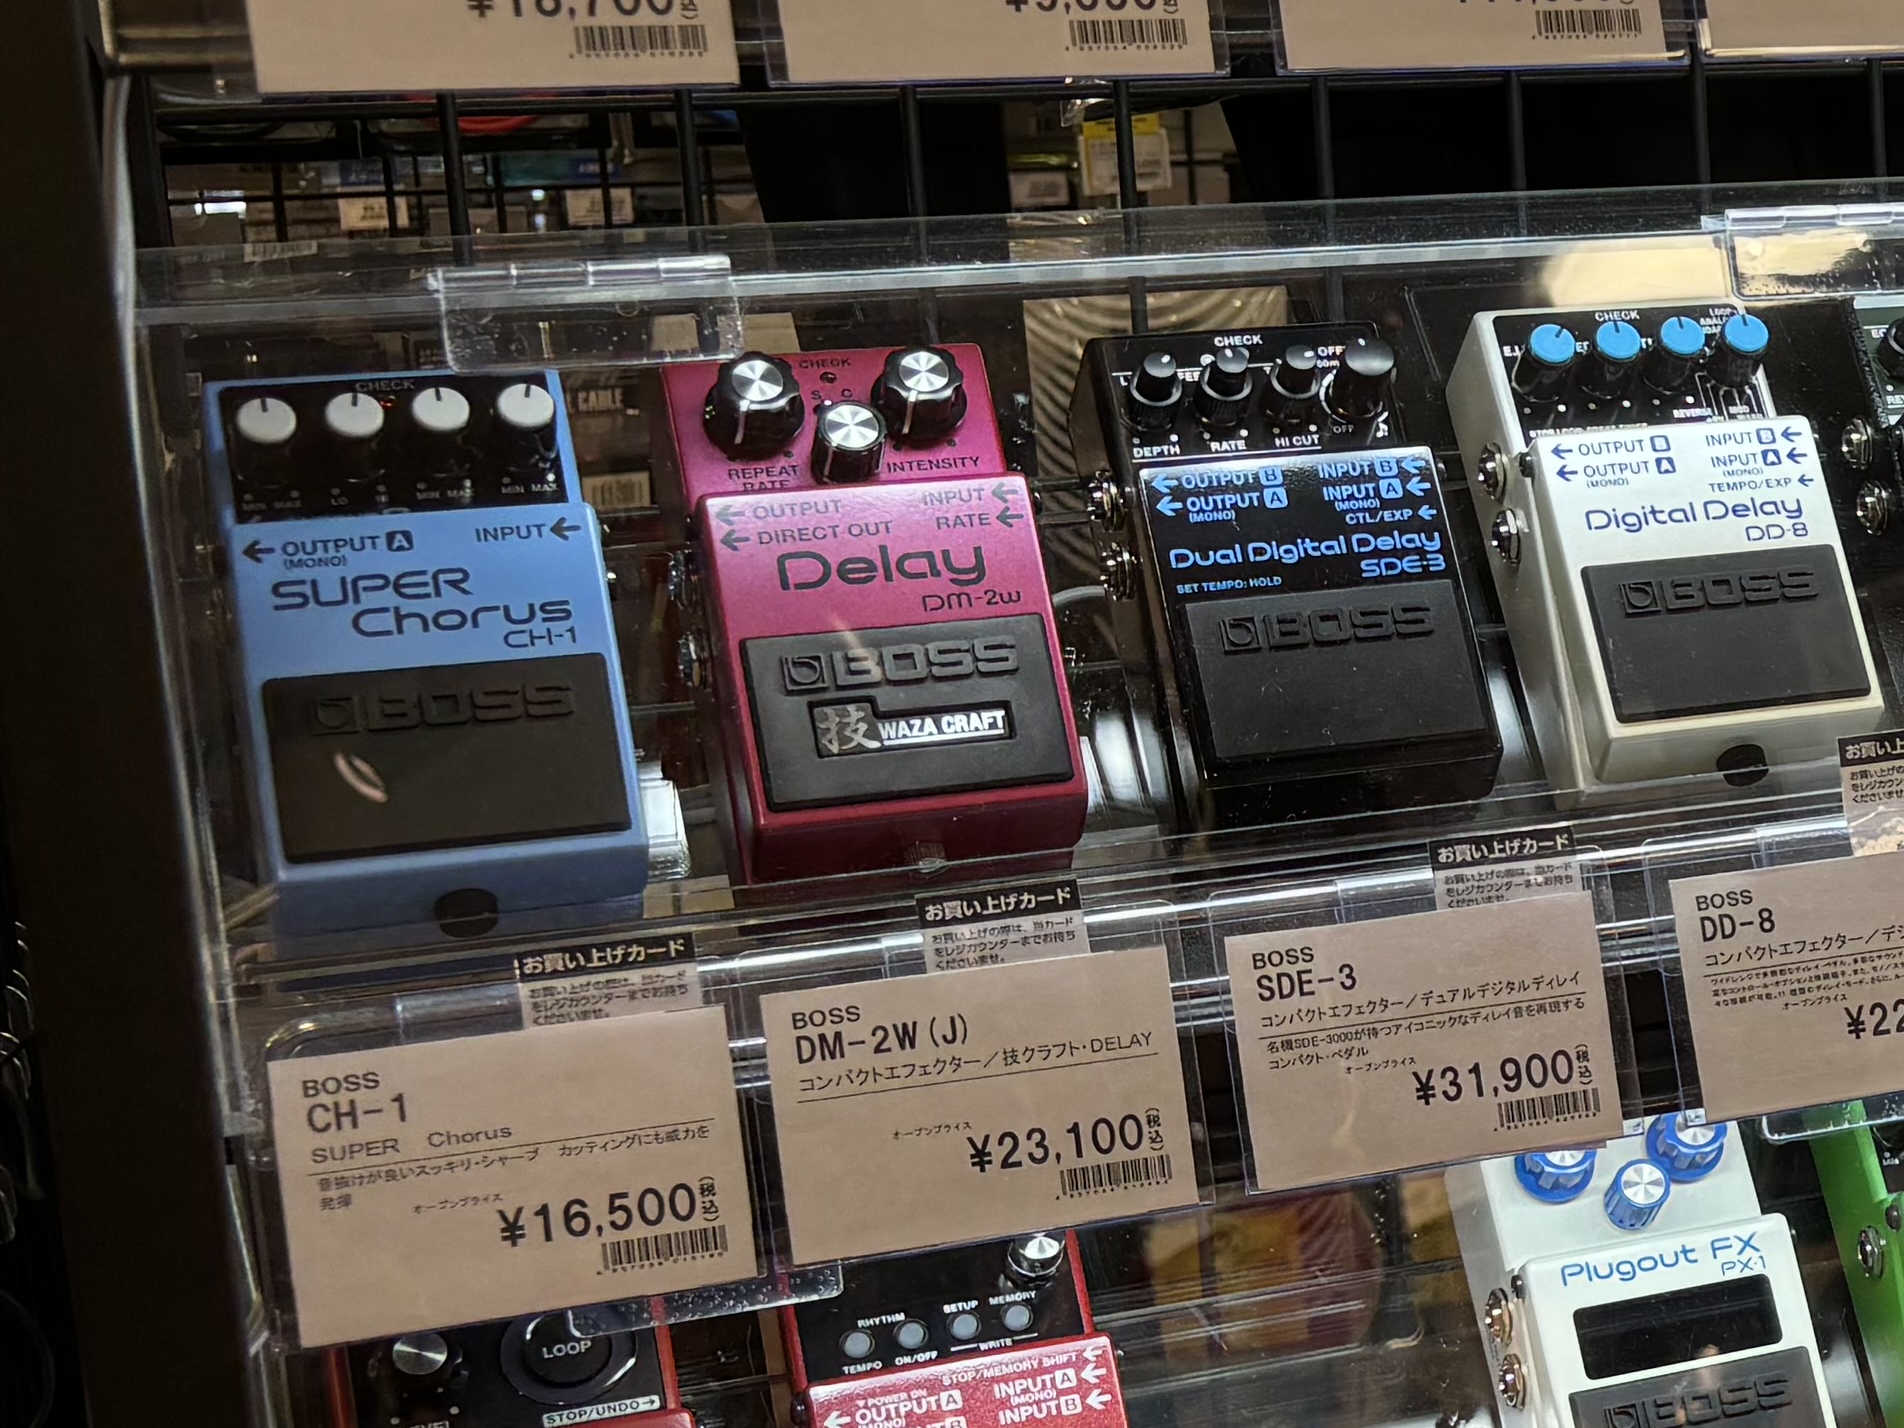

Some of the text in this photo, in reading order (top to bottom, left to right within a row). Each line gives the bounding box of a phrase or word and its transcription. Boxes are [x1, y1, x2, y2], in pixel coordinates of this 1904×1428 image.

[1584, 495, 1803, 533] Digital Delay
[1745, 524, 1809, 541] DD-8
[777, 546, 986, 588] Delay
[1170, 526, 1441, 568] Dual Digital Delay
[1360, 554, 1446, 578] SDE-3
[272, 569, 471, 609] SUPER
[353, 599, 572, 636] Chorus
[504, 626, 577, 647] CH-1
[1413, 1050, 1575, 1107] ¥31,900
[306, 1094, 408, 1134] CH-1
[498, 1183, 697, 1247] ¥16,500
[1561, 1231, 1759, 1287] Plugout FX
